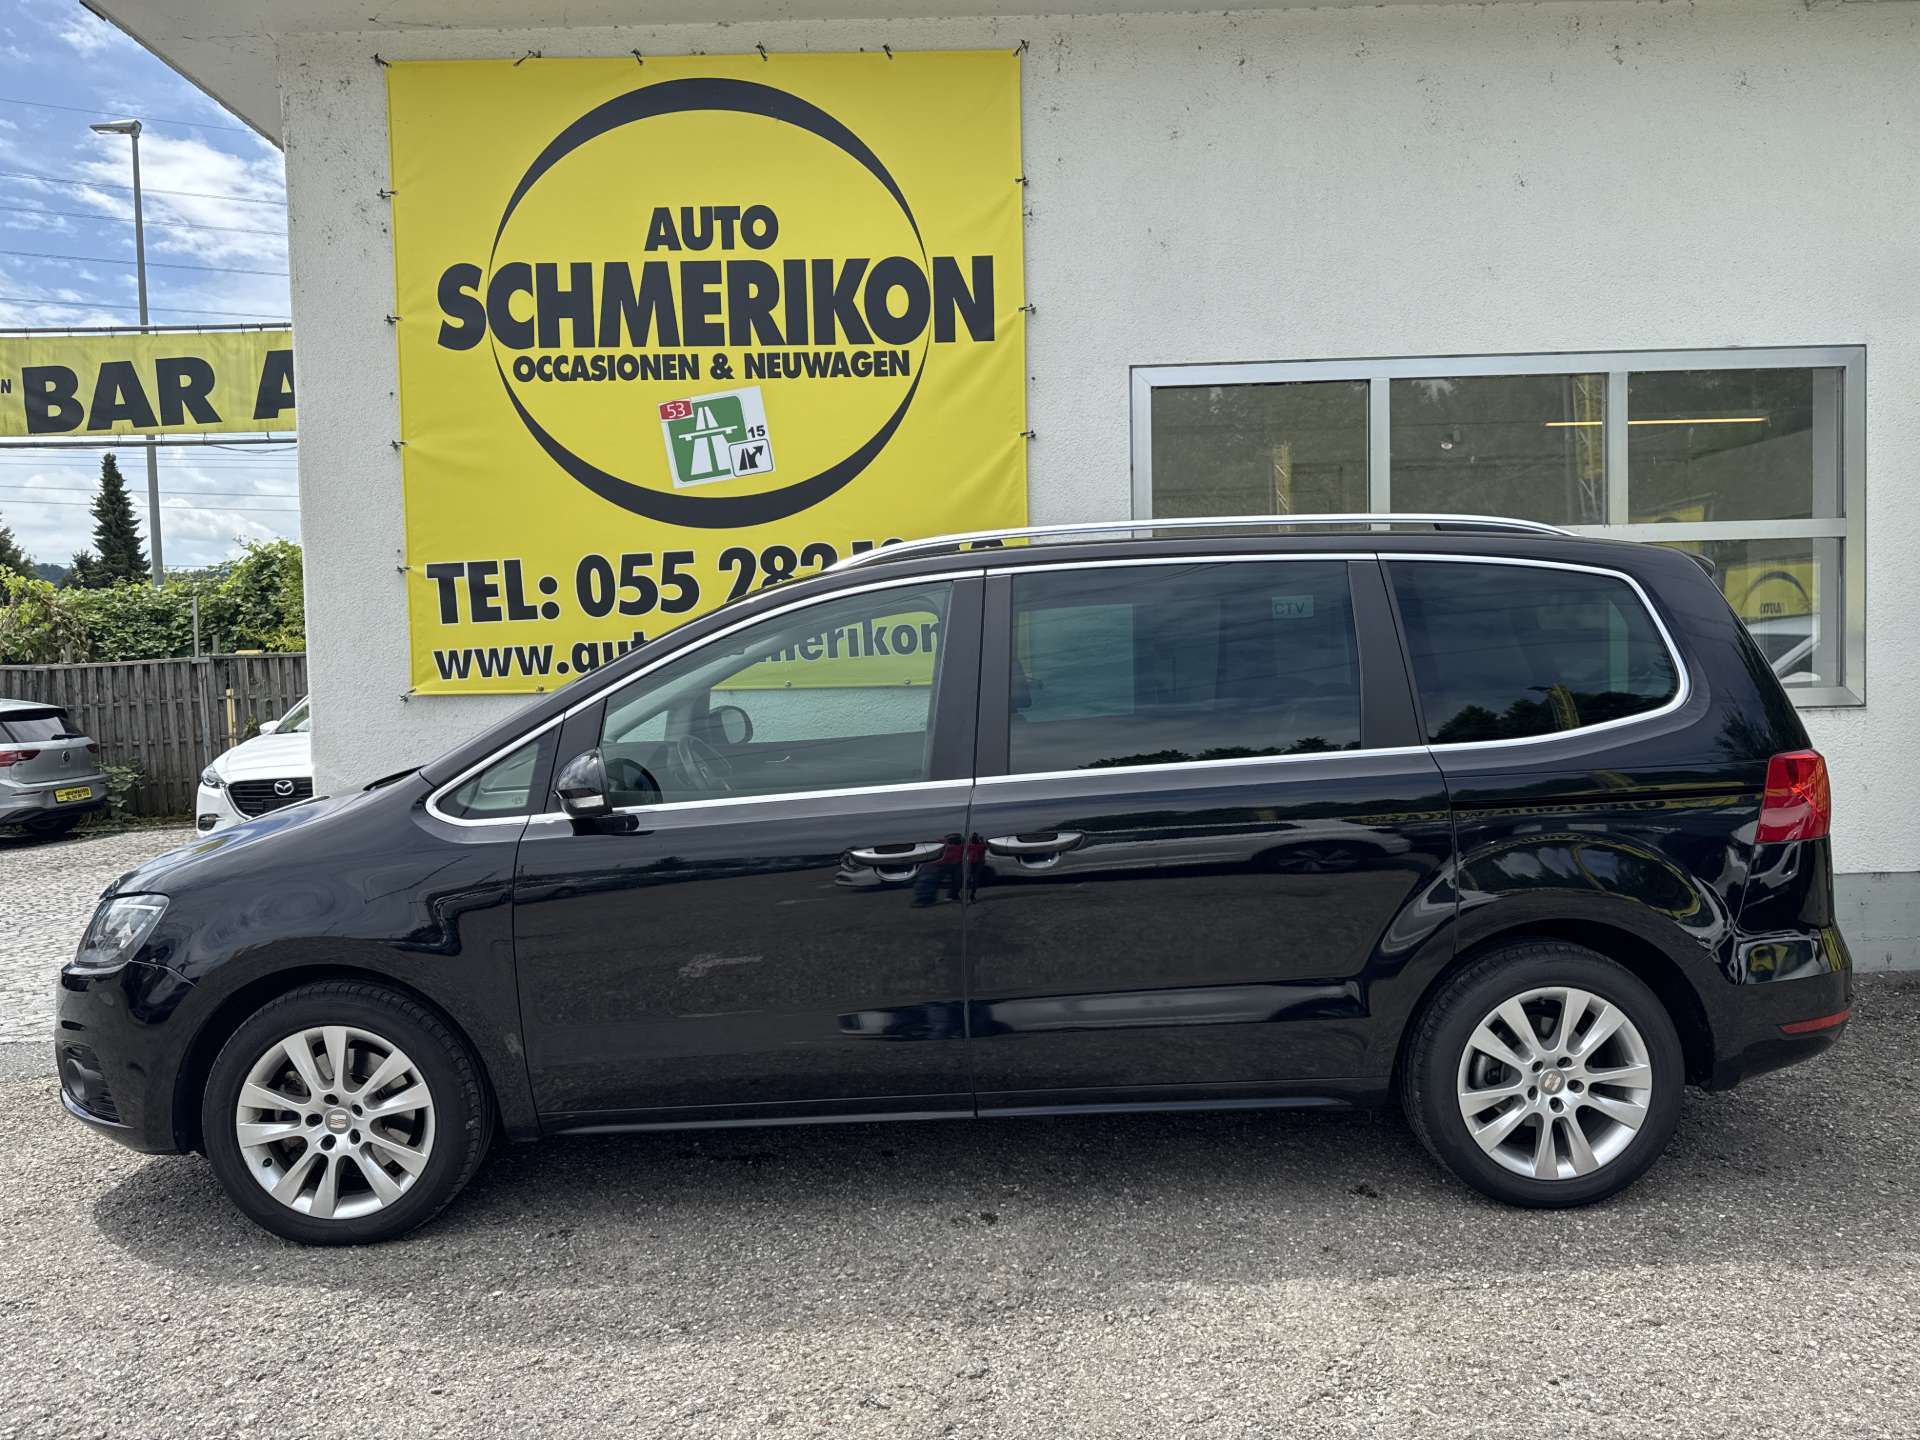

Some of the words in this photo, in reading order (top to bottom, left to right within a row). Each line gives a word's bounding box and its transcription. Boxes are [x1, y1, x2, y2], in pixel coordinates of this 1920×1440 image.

[644, 204, 779, 251] AUTO
[437, 255, 995, 350] SCHMERIKON
[512, 353, 700, 382] OCCASIONEN
[709, 352, 735, 380] &
[743, 350, 911, 380] NEUWAGEN
[22, 356, 223, 434] BAR
[666, 402, 686, 419] 53
[747, 425, 766, 439] 15
[426, 559, 561, 624] TEL:
[575, 550, 701, 618] 055
